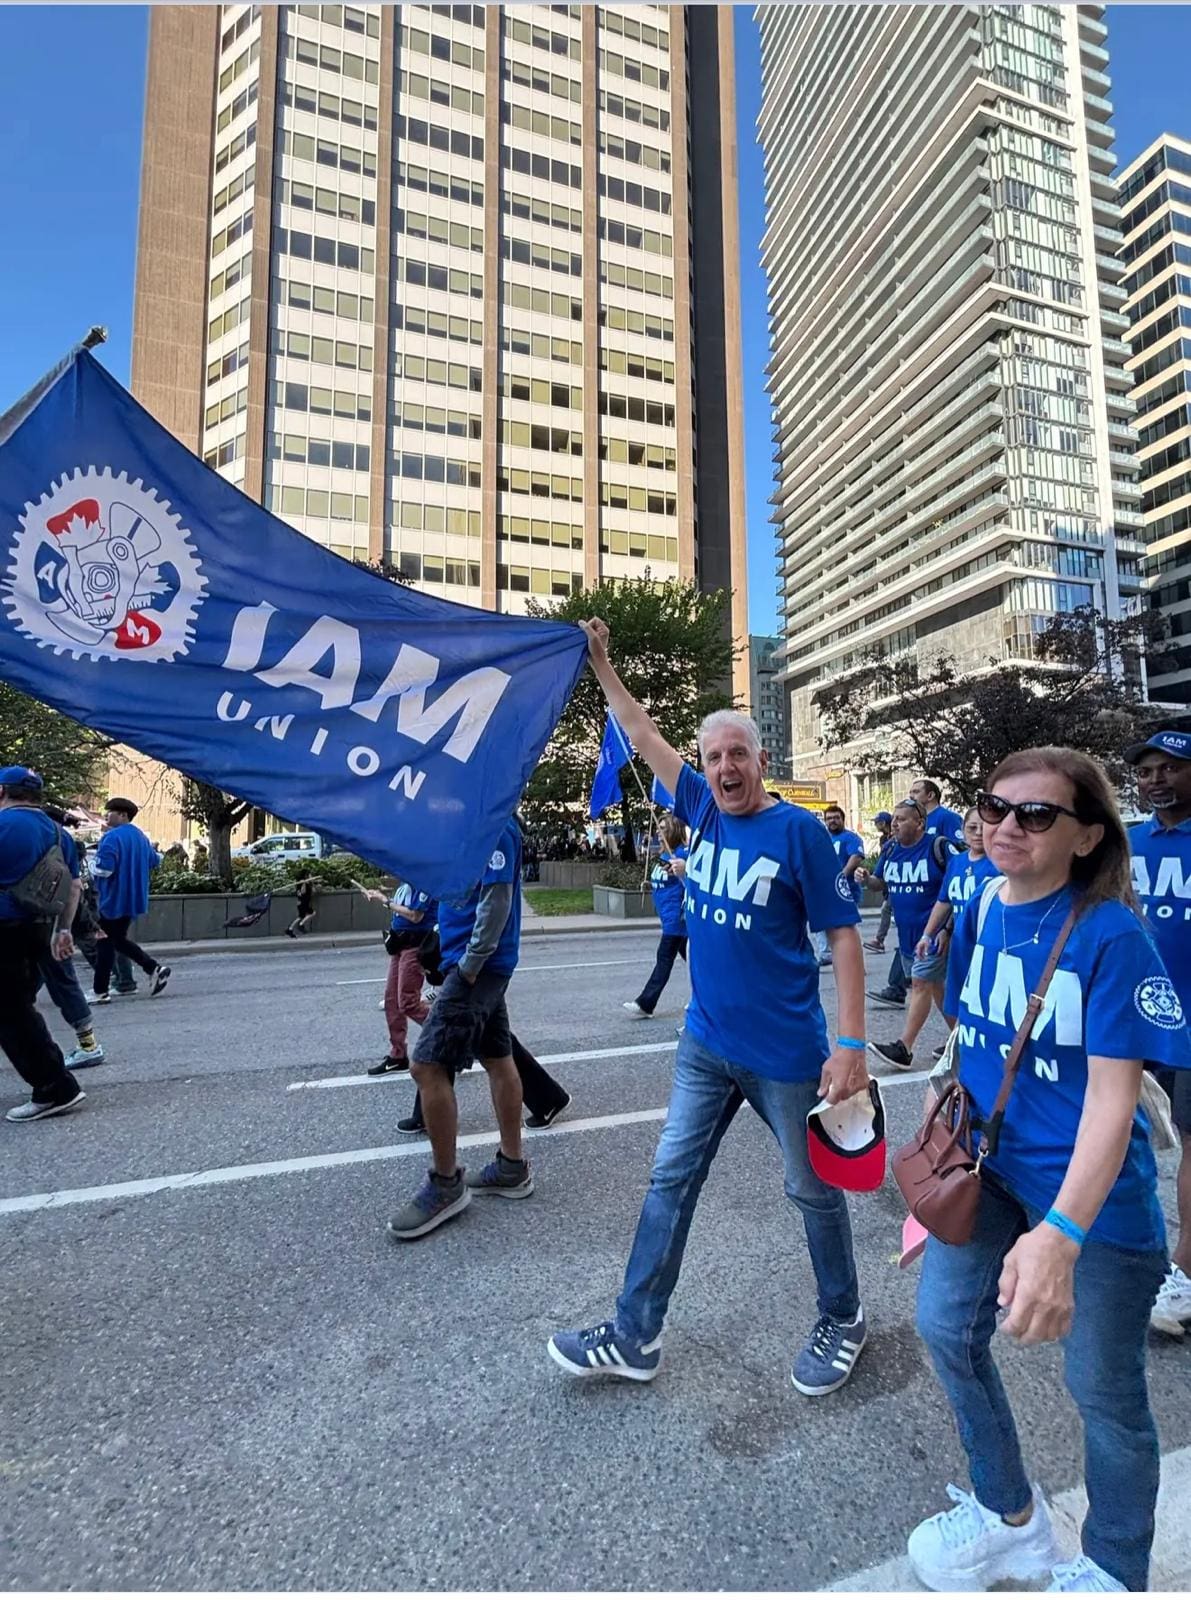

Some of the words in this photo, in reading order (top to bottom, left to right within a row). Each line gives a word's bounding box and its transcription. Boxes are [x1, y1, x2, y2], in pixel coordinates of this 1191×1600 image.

[37, 561, 57, 590] A
[126, 618, 150, 645] M
[221, 600, 512, 764] IAM
[216, 690, 427, 800] UNION
[1161, 735, 1187, 747] IAM
[687, 895, 752, 931] NION
